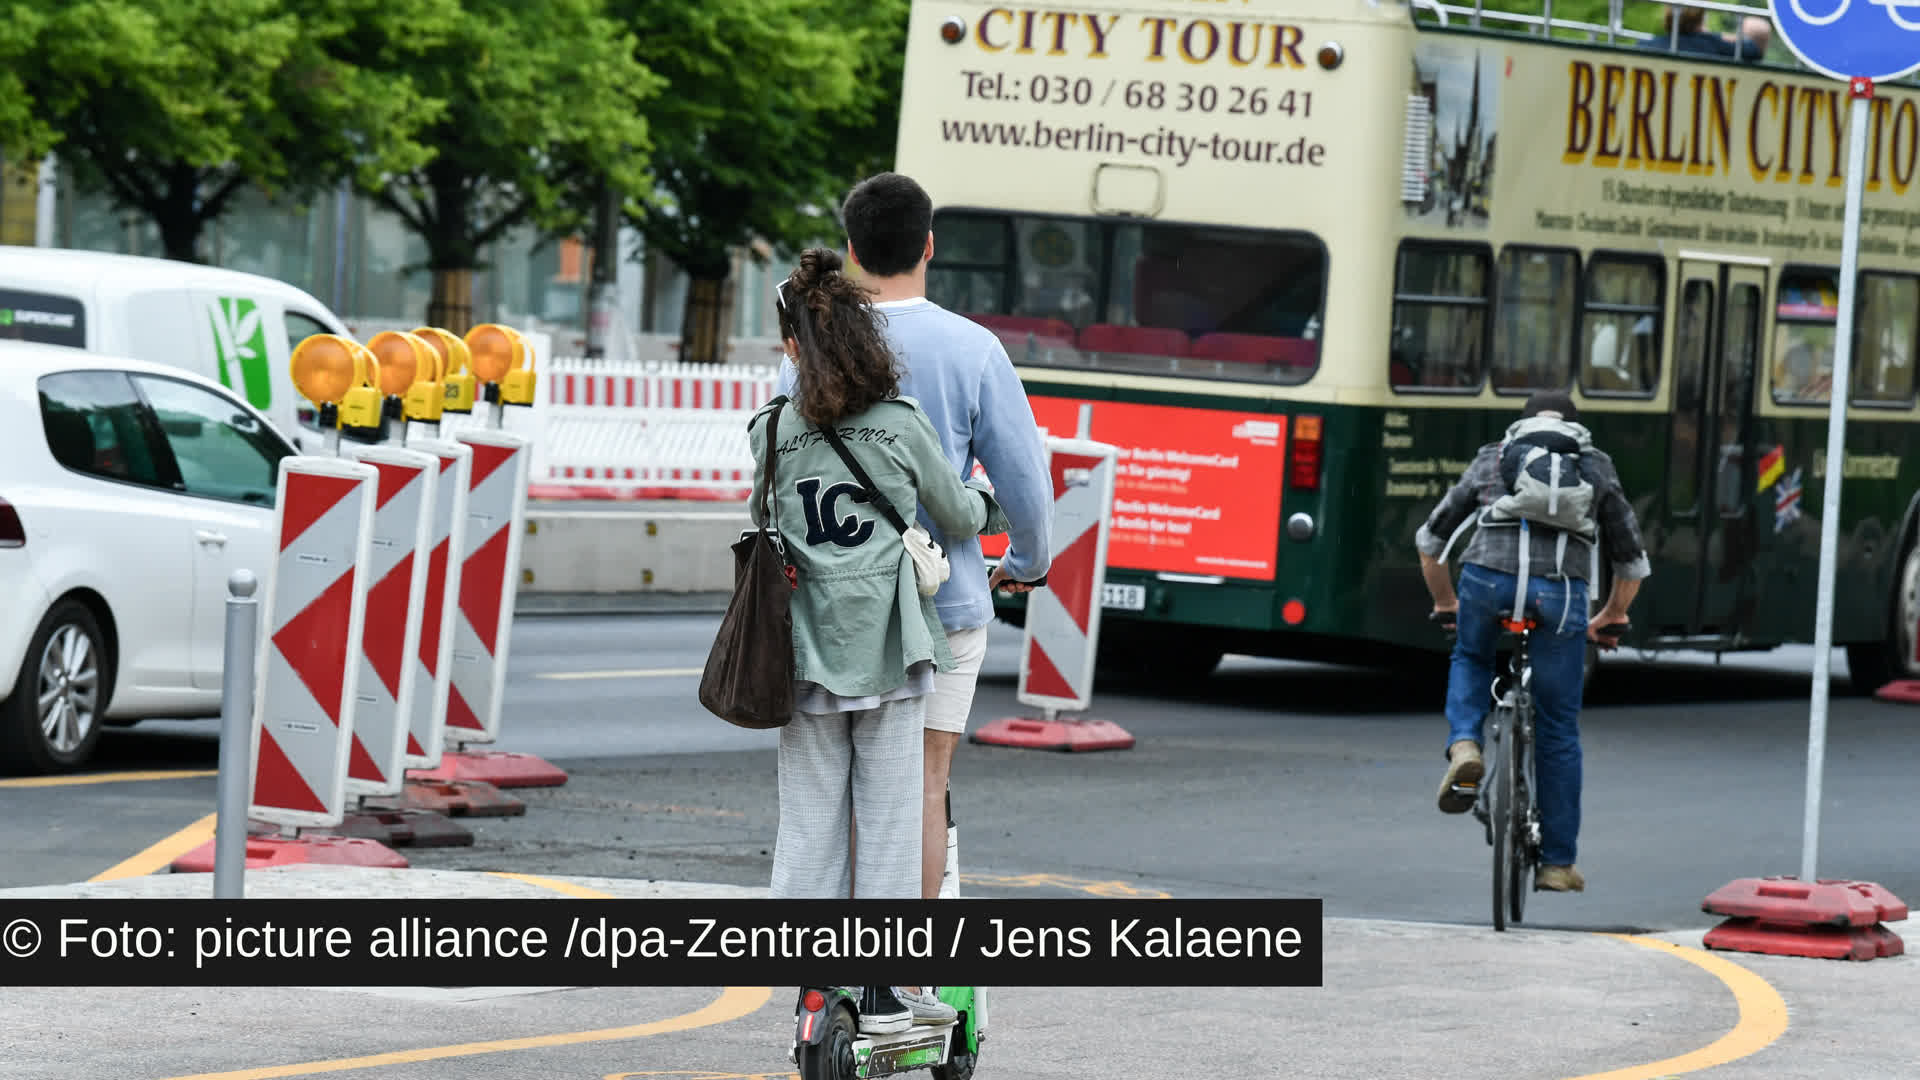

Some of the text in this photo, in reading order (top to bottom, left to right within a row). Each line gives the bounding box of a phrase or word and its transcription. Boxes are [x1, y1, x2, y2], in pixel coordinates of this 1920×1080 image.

[974, 9, 1307, 69] CITY TOUR
[961, 70, 1313, 118] Tel.: 030 / 68 30 26 41
[941, 118, 1326, 167] www.berlin-city-tour.de
[1562, 61, 1738, 175] BERLIN
[1748, 80, 1851, 187] CITY
